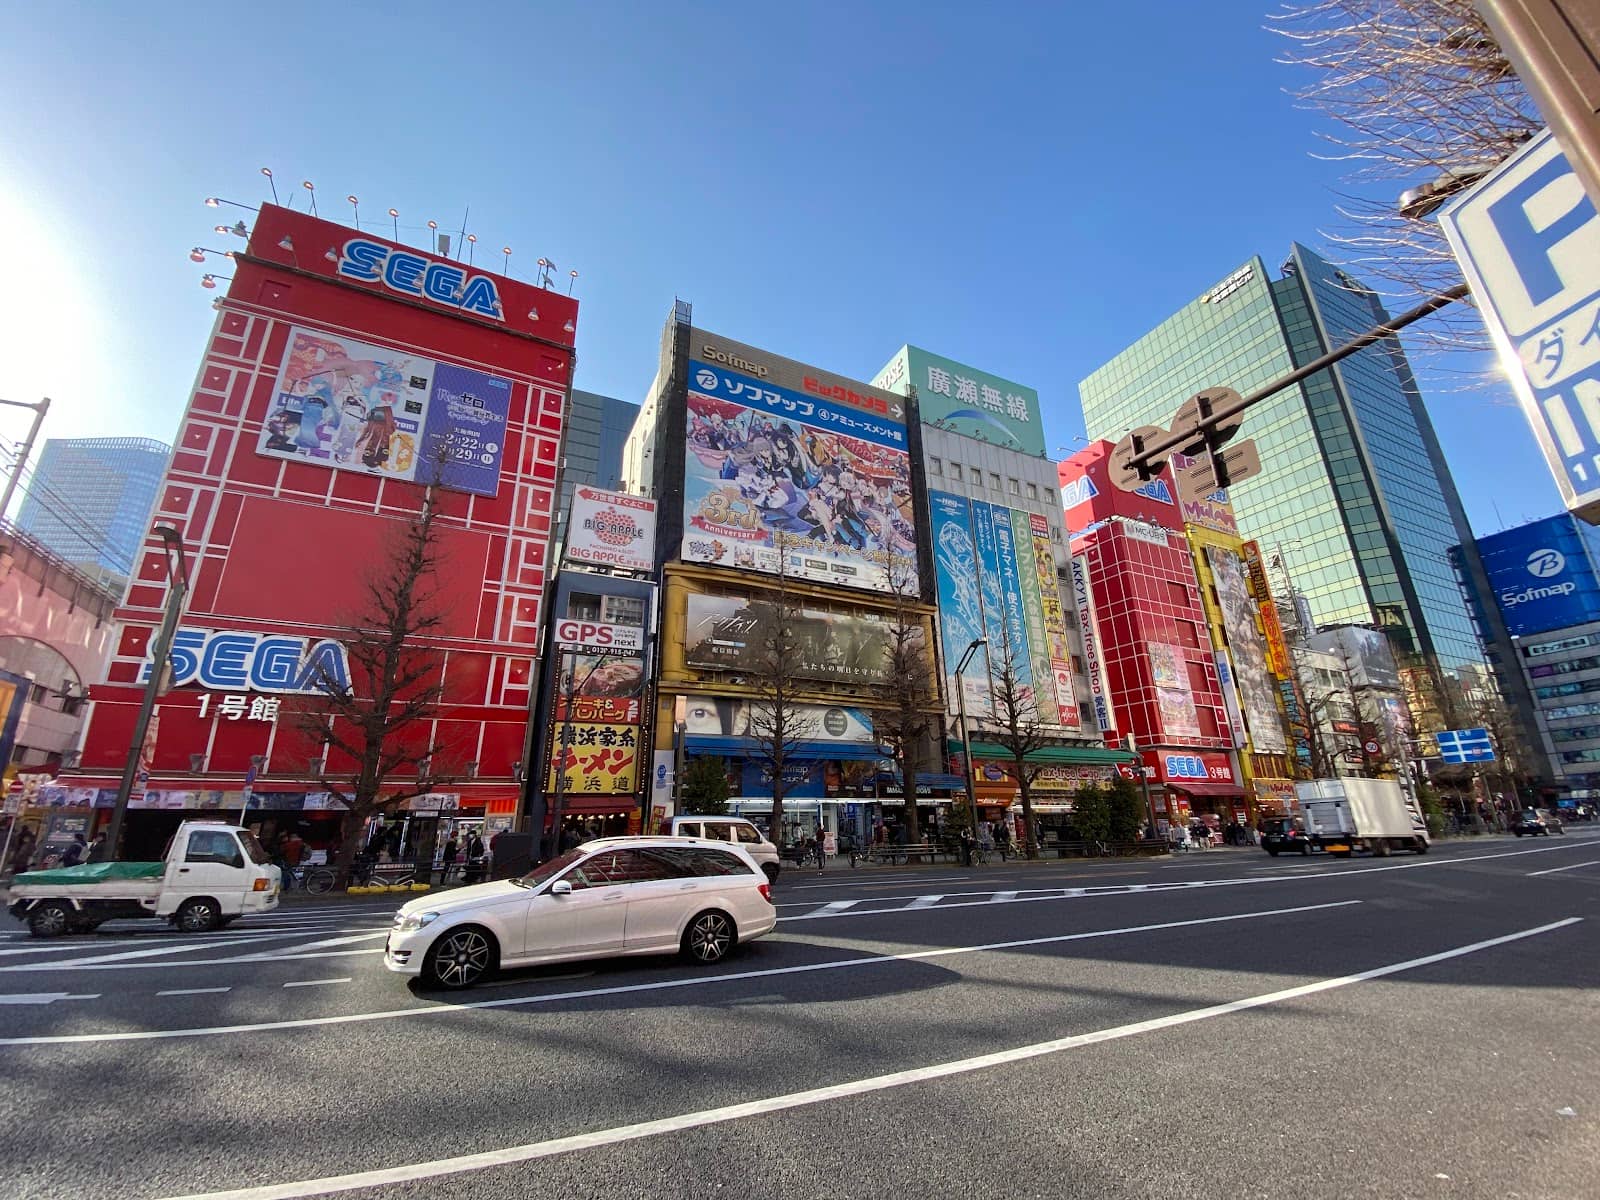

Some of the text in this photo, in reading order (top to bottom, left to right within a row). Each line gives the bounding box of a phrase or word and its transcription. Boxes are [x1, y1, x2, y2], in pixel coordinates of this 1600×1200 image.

[1487, 152, 1600, 307] P
[339, 239, 505, 321] SEGA
[703, 345, 768, 377] Sofmap
[724, 377, 815, 416] ソフマップ
[802, 376, 888, 413] ビックカメラ
[927, 366, 1030, 422] 廣瀬無線
[584, 518, 643, 537] BIG APPLE
[704, 523, 756, 539] Anniversary
[570, 547, 591, 558] BIG
[1501, 581, 1576, 607] Sofmap
[560, 622, 613, 645] GPS
[1072, 562, 1087, 595] AKKY
[1080, 607, 1095, 659] Tax-free
[1089, 663, 1101, 693] Shop
[615, 639, 636, 647] next
[142, 626, 354, 696] SEGA
[197, 694, 281, 722] 1号館
[627, 699, 639, 722] 2F
[555, 726, 635, 747] 横浜家系
[551, 746, 634, 775] ラーメン
[1166, 756, 1209, 779] SEGA
